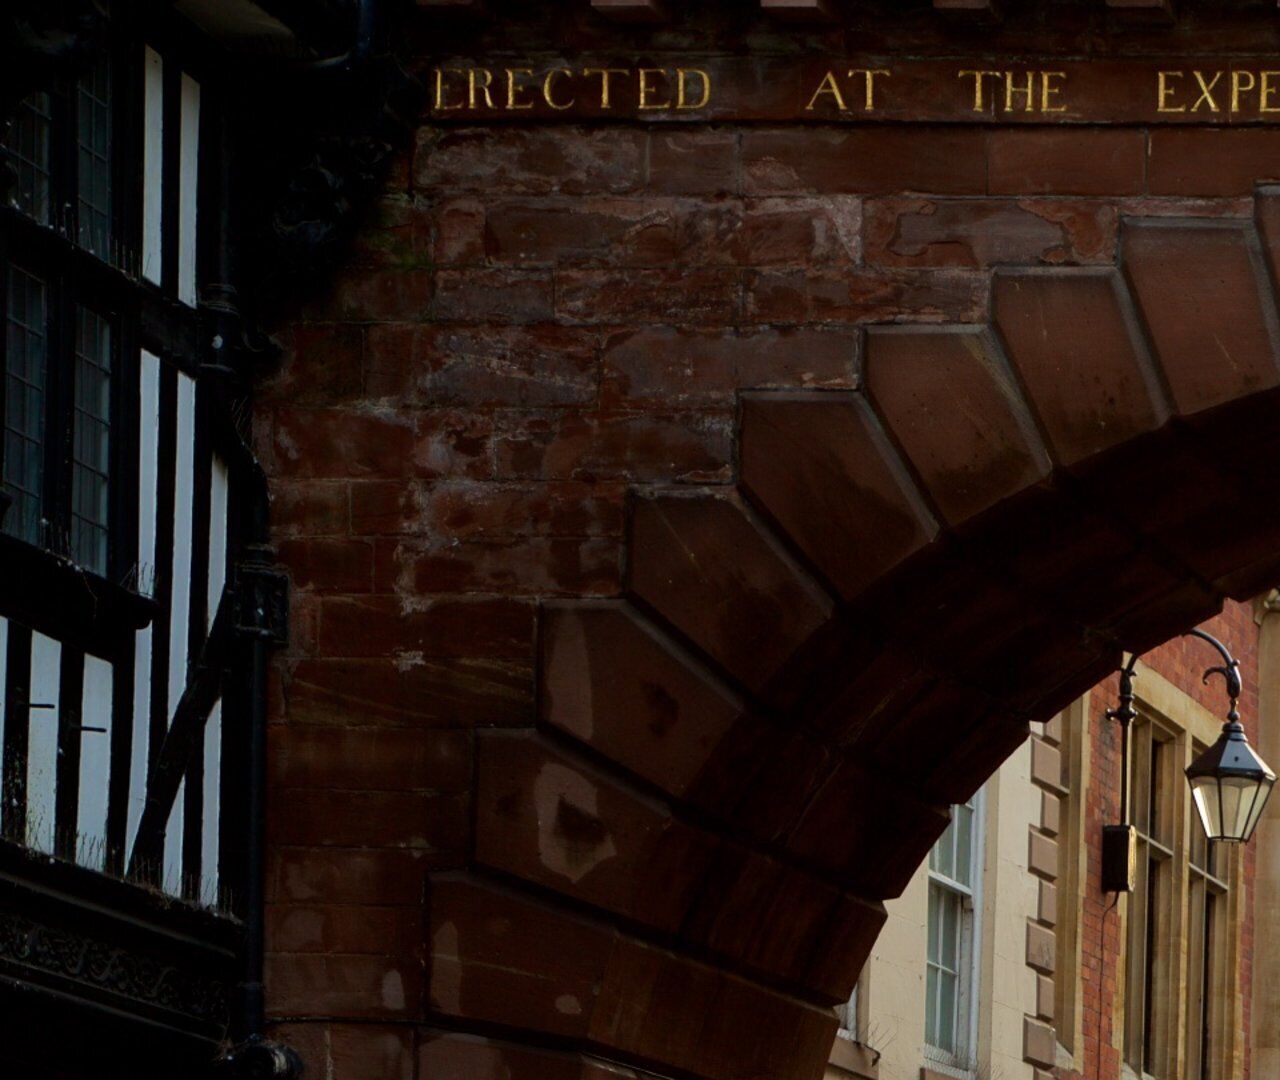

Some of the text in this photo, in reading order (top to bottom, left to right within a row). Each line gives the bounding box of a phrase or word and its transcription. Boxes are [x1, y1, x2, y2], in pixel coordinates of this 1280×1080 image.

[434, 68, 711, 111] ERECTED
[805, 70, 890, 111] AT
[958, 69, 1067, 113] THE
